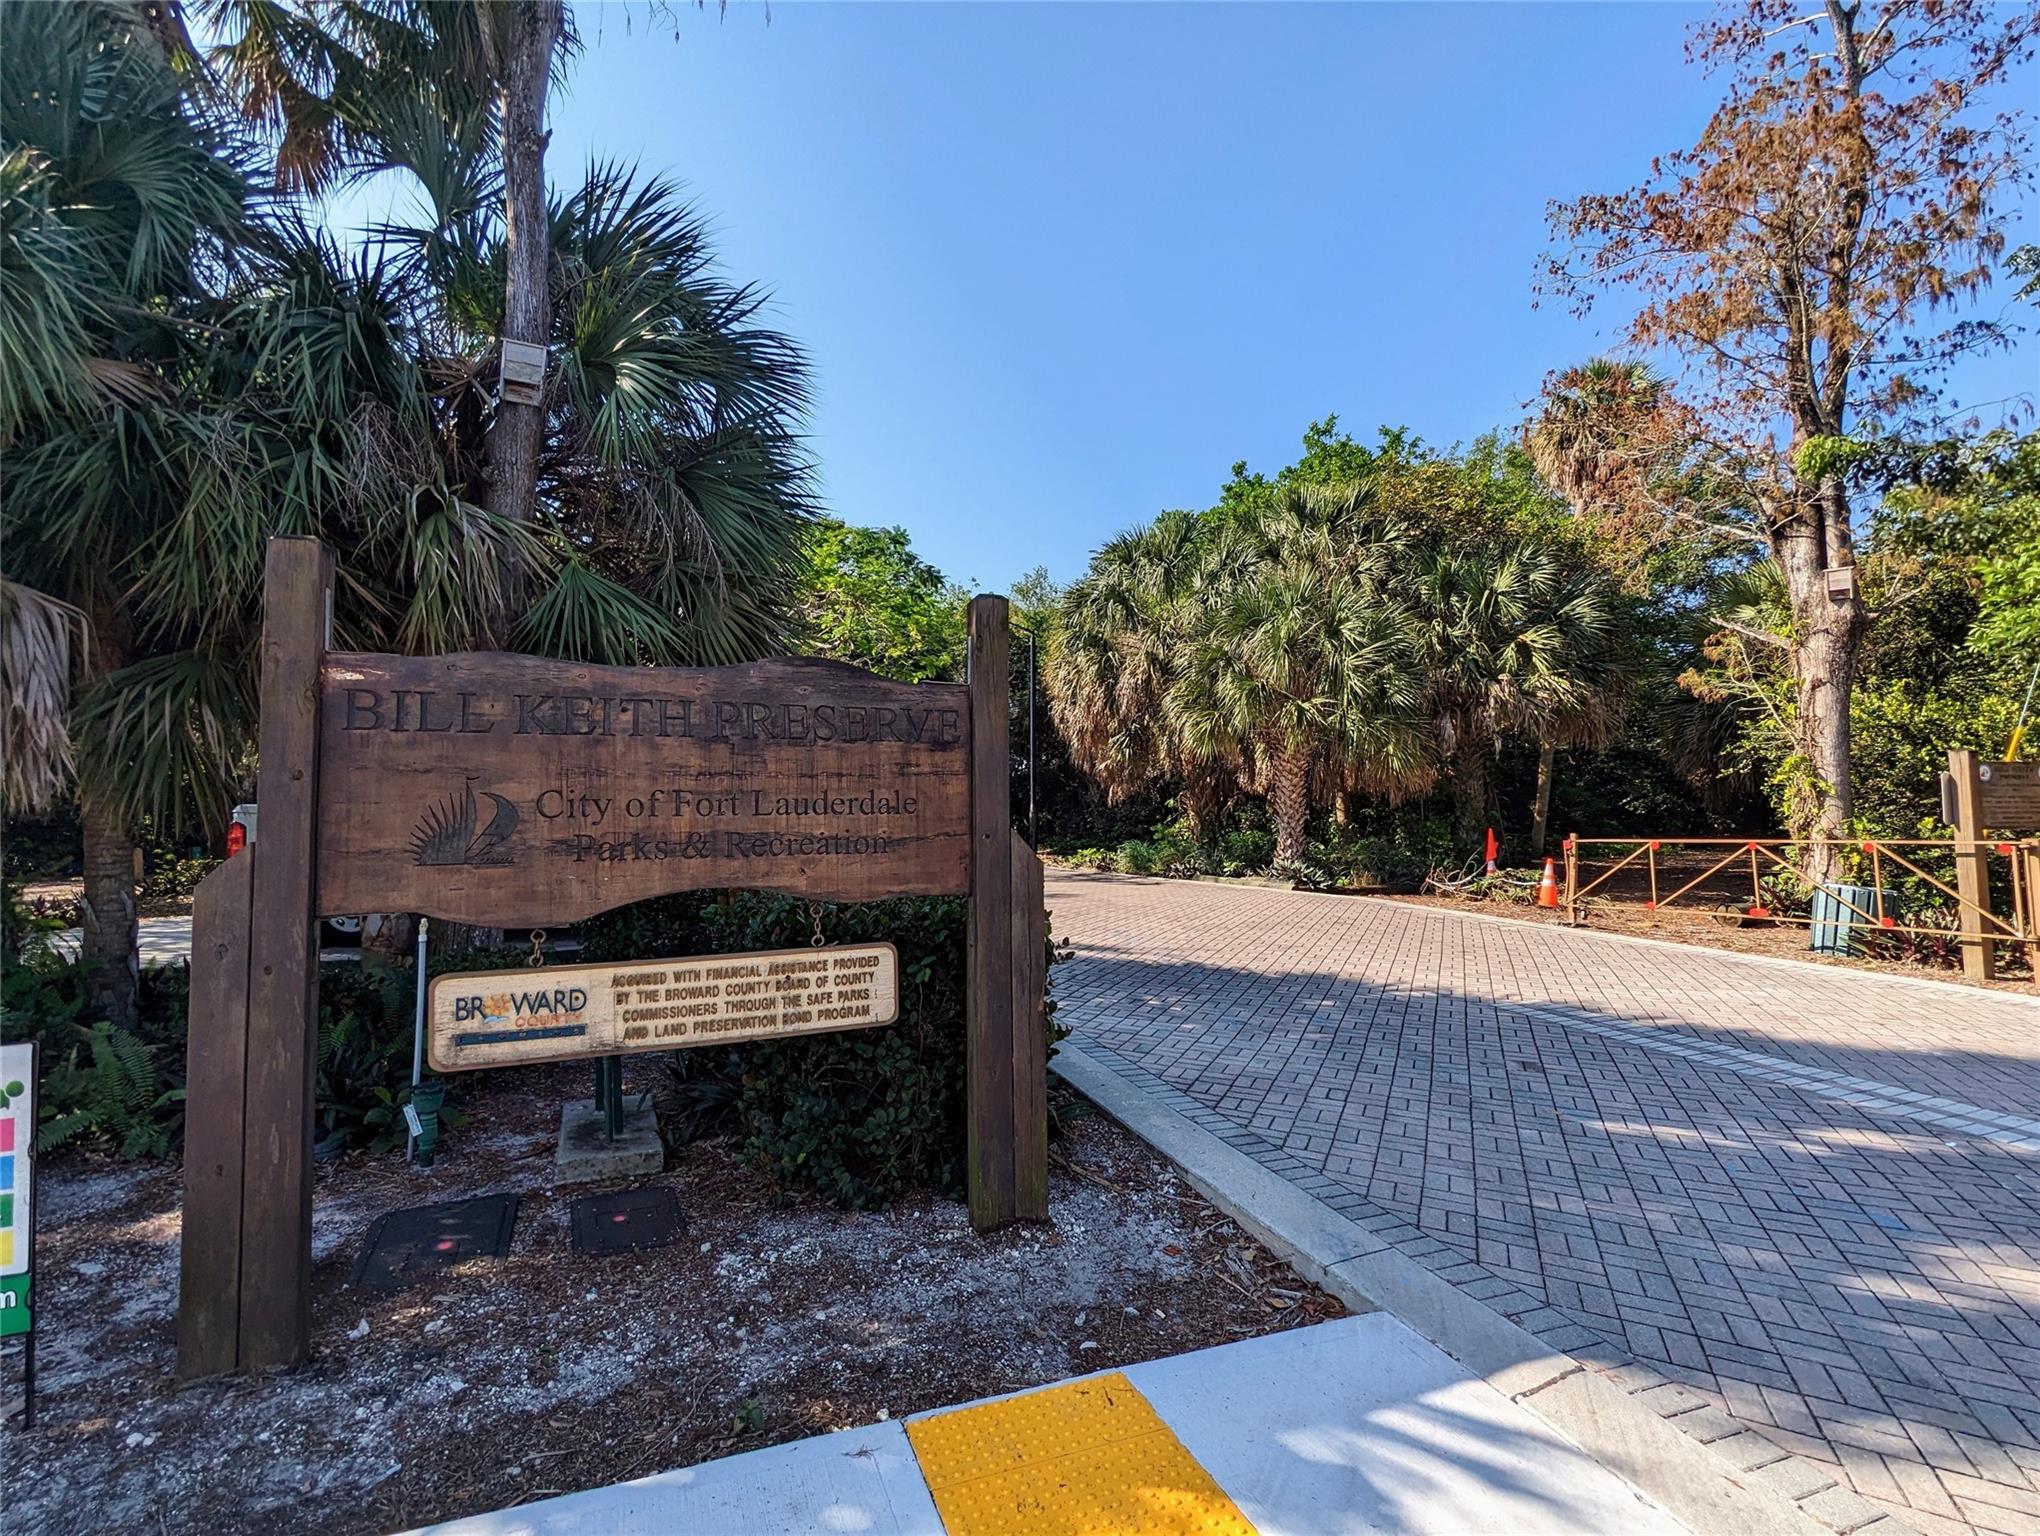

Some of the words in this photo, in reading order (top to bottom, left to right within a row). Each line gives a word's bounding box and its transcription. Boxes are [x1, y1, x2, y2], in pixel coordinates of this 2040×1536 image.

[342, 688, 495, 733] BILL
[513, 694, 697, 737] KEITH
[711, 700, 961, 744] PRESERVE
[536, 789, 612, 825] City
[626, 789, 663, 818] of
[671, 789, 740, 817] Fort
[751, 789, 918, 816] Lauderdale
[573, 834, 668, 862] Parks
[680, 831, 711, 860] &
[724, 831, 889, 858] Recreation
[673, 969, 701, 983] WITH
[706, 965, 762, 981] FINANCIAL
[833, 955, 880, 971] PROVIDED
[616, 991, 631, 1006] BY
[637, 990, 660, 1004] THE
[665, 985, 720, 1001] BROWARD
[725, 980, 771, 996] COUNTY
[815, 975, 829, 989] OF
[834, 971, 875, 987] COUNTY
[622, 1003, 718, 1023] COMMISSIONERS
[724, 997, 776, 1014] THROUGH
[781, 993, 802, 1009] THE
[806, 991, 833, 1006] SAFE
[838, 988, 870, 1003] PARKS
[654, 1022, 687, 1038] LAND
[693, 1015, 777, 1034] PRESERVATION
[817, 1004, 870, 1021] PROGRAM
